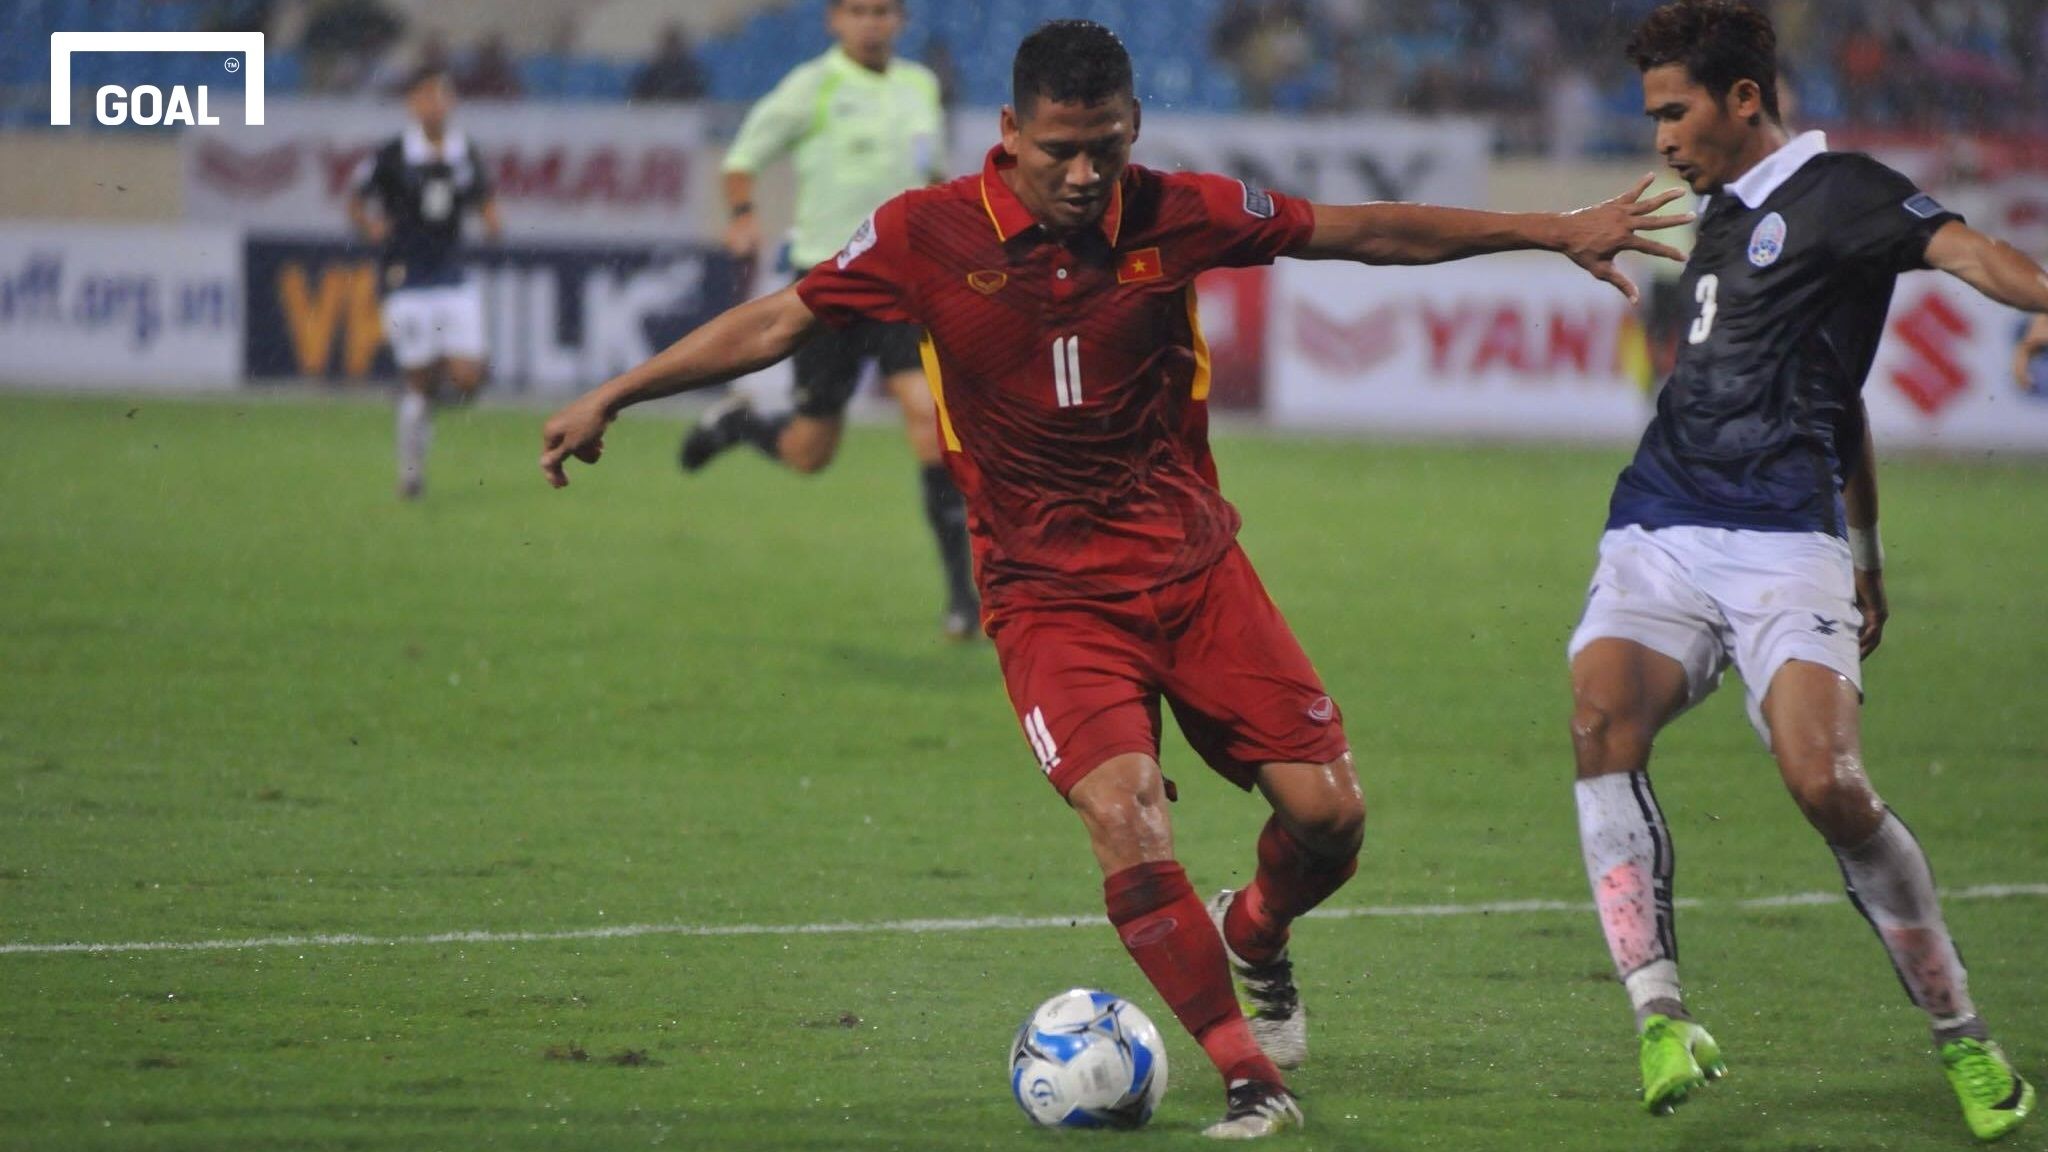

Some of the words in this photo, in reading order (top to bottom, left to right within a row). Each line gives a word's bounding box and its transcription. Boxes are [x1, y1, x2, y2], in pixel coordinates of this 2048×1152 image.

[1416, 298, 1626, 378] YAN
[1688, 274, 1719, 345] 3
[1053, 335, 1083, 407] 11
[1025, 705, 1061, 774] 11
